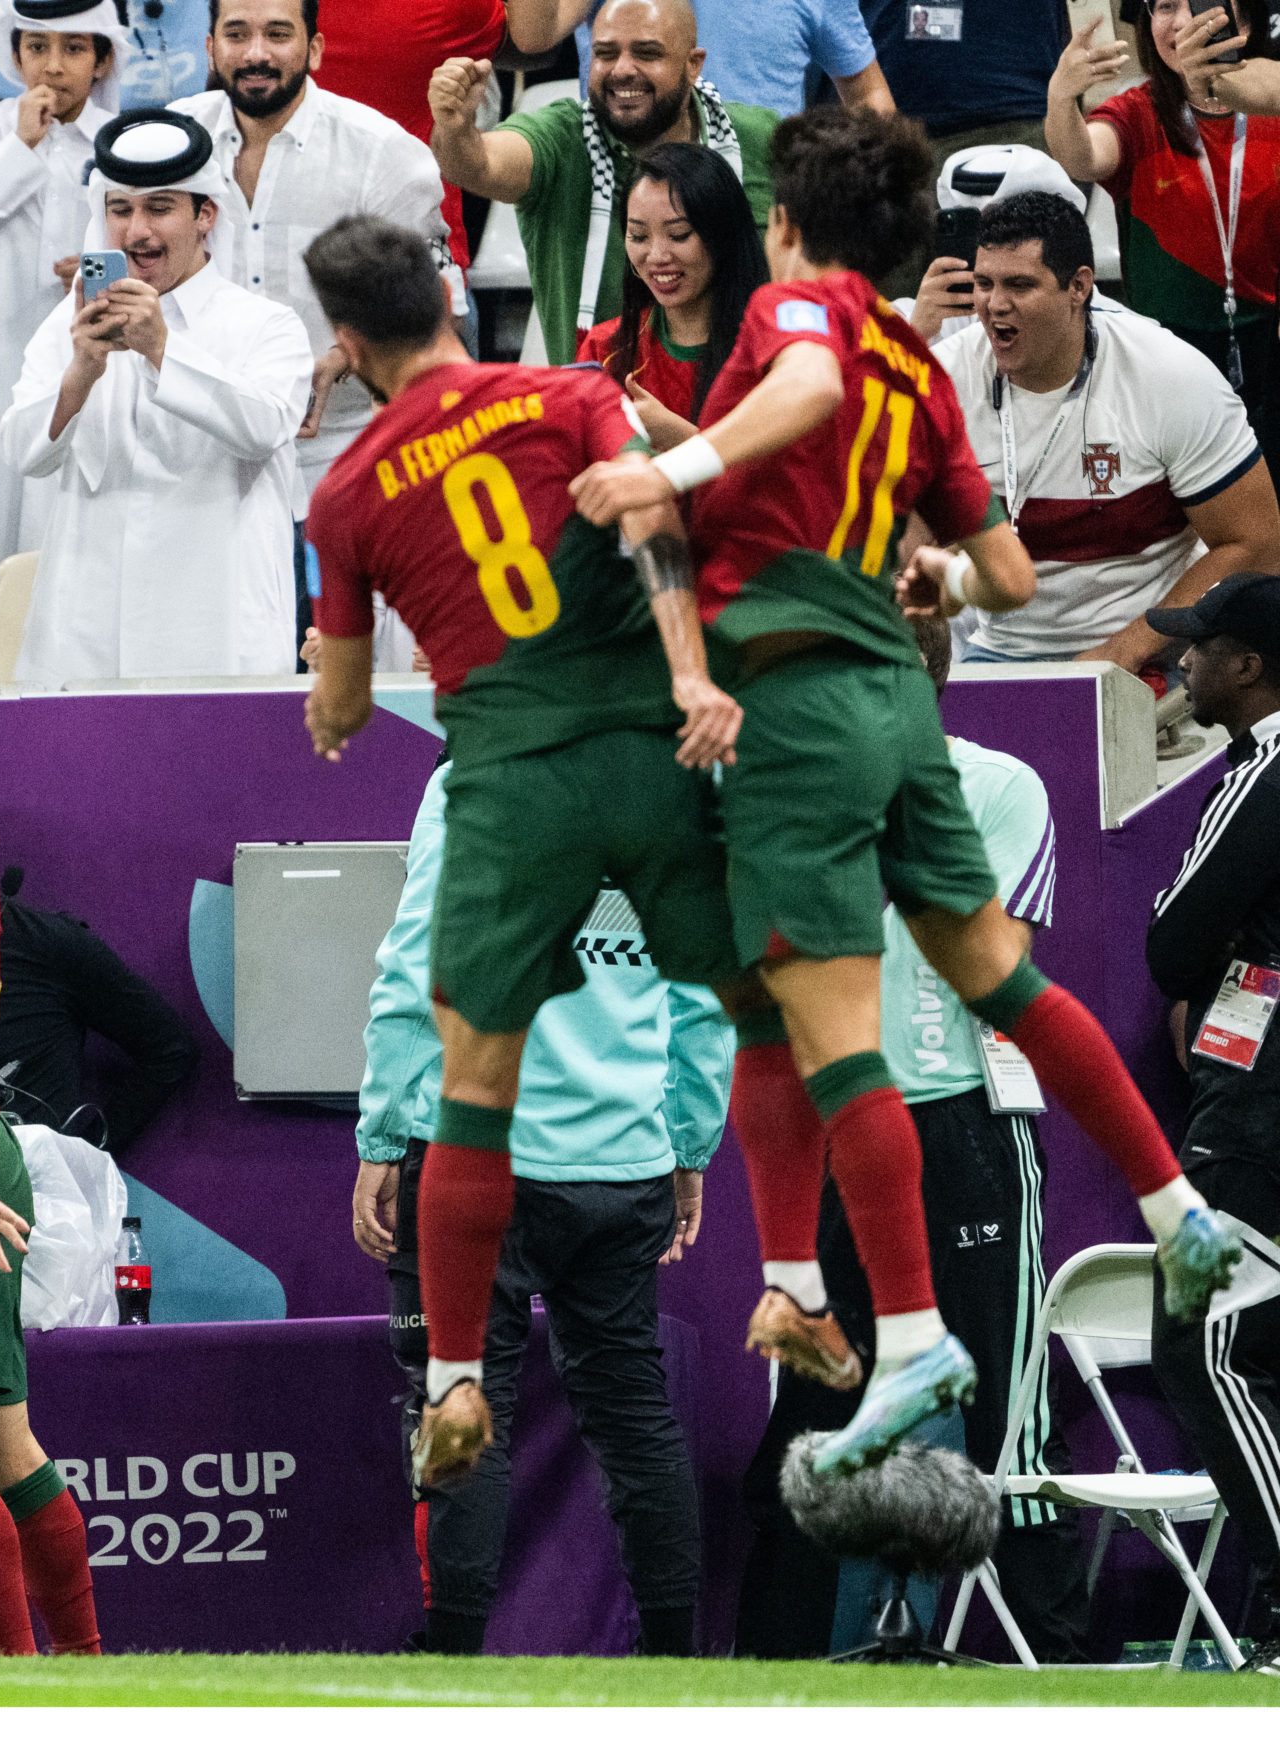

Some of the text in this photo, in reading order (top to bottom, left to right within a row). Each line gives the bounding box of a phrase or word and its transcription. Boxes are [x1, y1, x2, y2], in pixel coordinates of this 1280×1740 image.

[826, 375, 916, 578] 11
[443, 452, 561, 638] 8
[911, 964, 948, 1076] Volun
[390, 1314, 430, 1328] POLICE
[54, 1456, 169, 1501] RLD
[181, 1451, 297, 1498] CUP
[88, 1510, 267, 1567] 2022
